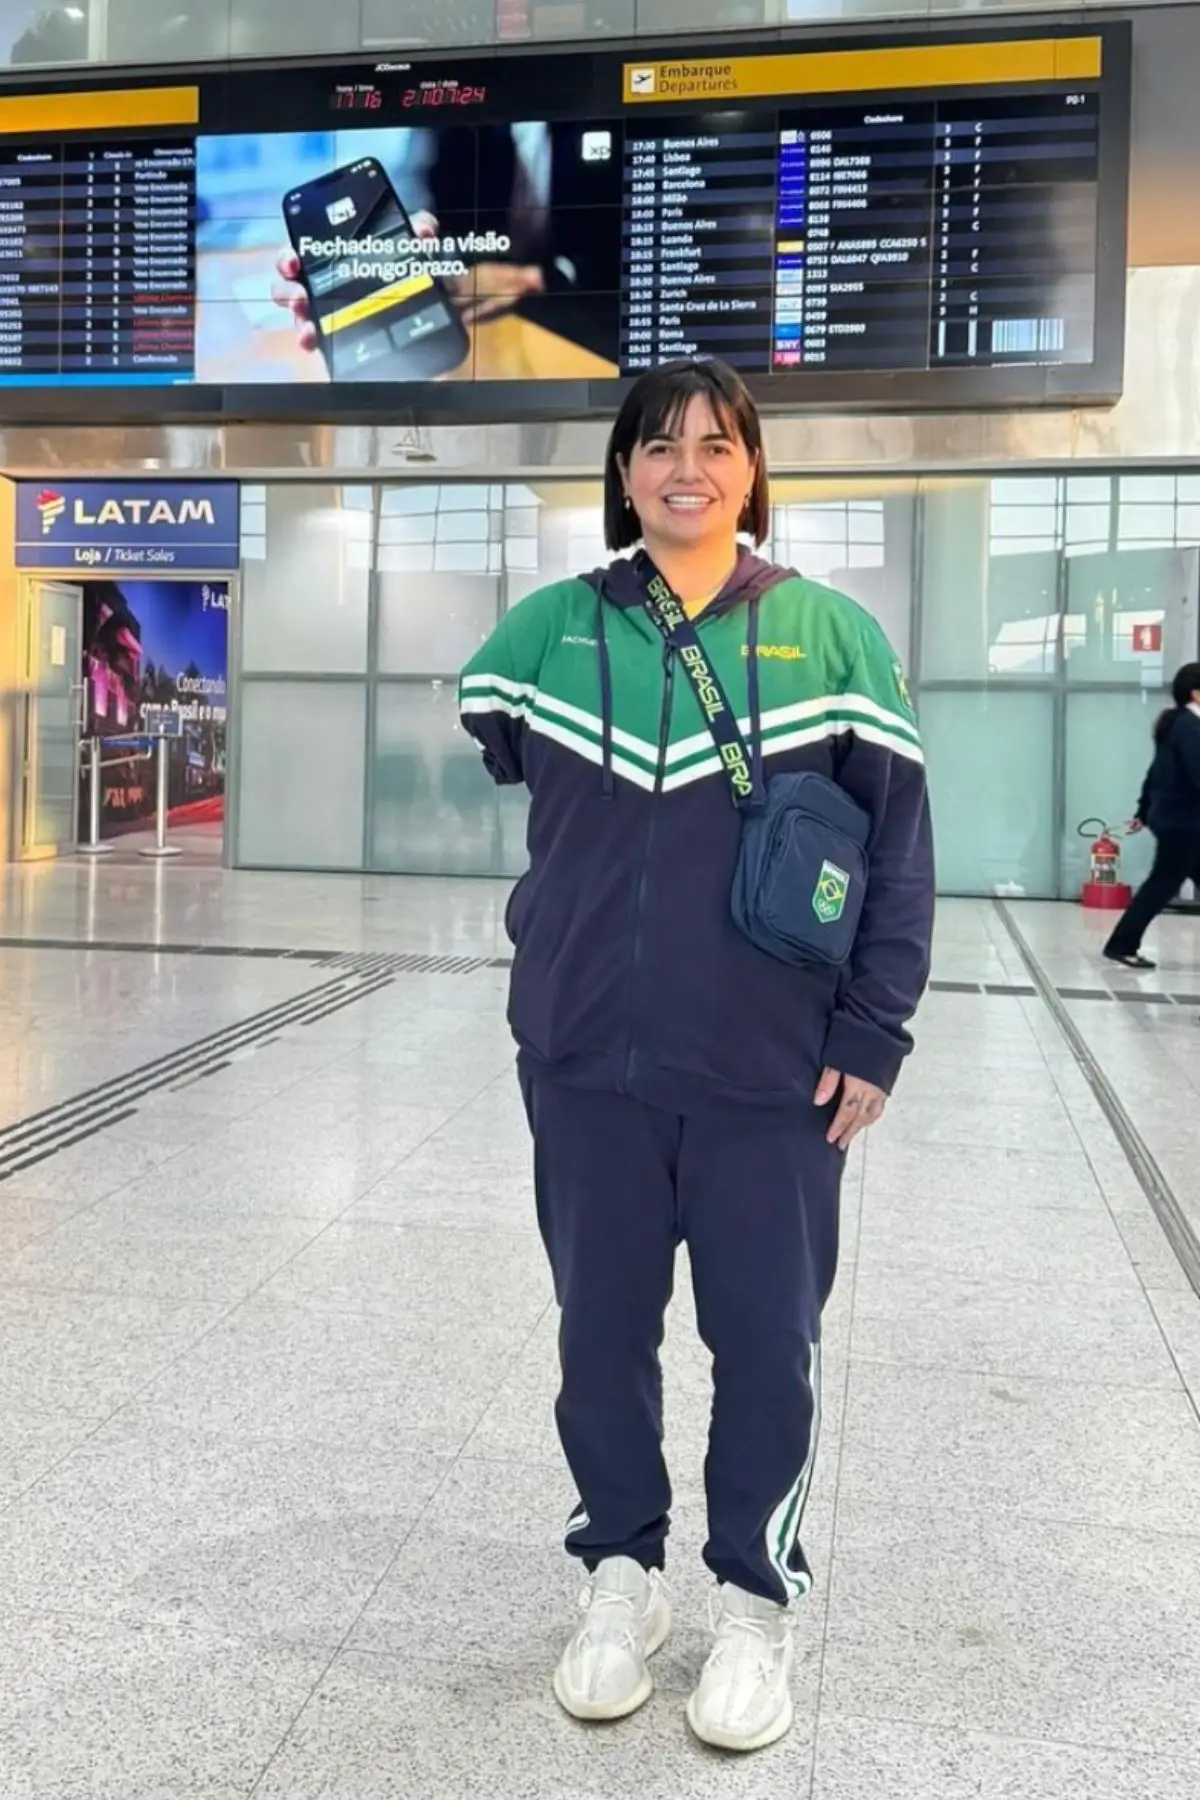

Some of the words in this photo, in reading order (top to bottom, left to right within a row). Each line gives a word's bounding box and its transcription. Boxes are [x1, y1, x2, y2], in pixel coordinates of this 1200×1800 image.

[660, 64, 732, 79] Embarque
[660, 79, 738, 95] Departures
[663, 138, 695, 150] Buenos
[696, 137, 719, 147] Aires
[663, 152, 691, 163] Lisboa
[662, 165, 702, 178] Santiago
[662, 179, 706, 190] Barcelona
[661, 207, 683, 218] Paris
[661, 221, 693, 231] Buenos
[694, 219, 717, 230] Aires
[300, 235, 393, 256] Fechados
[397, 236, 441, 255] com
[443, 238, 455, 253] a
[458, 231, 511, 252] visão
[660, 247, 702, 258] Frankfurt
[338, 262, 349, 277] a
[351, 260, 408, 282] longo
[411, 260, 468, 280] prazo.
[660, 261, 700, 273] Santiago
[660, 275, 692, 286] Buenos
[693, 274, 716, 284] Aires
[659, 302, 685, 312] Santa
[686, 301, 706, 312] Cruz
[707, 301, 718, 311] de
[720, 301, 730, 310] La
[731, 299, 757, 310] Sierra
[658, 316, 681, 326] Paris
[658, 329, 684, 339] Roma
[658, 342, 698, 354] Santiago
[74, 499, 215, 525] LATAM
[74, 548, 101, 565] Loja
[104, 546, 112, 563] /
[114, 549, 145, 562] Ticket
[147, 549, 175, 562] Sales
[680, 644, 725, 723] BRASIL
[720, 742, 753, 797] BRA
